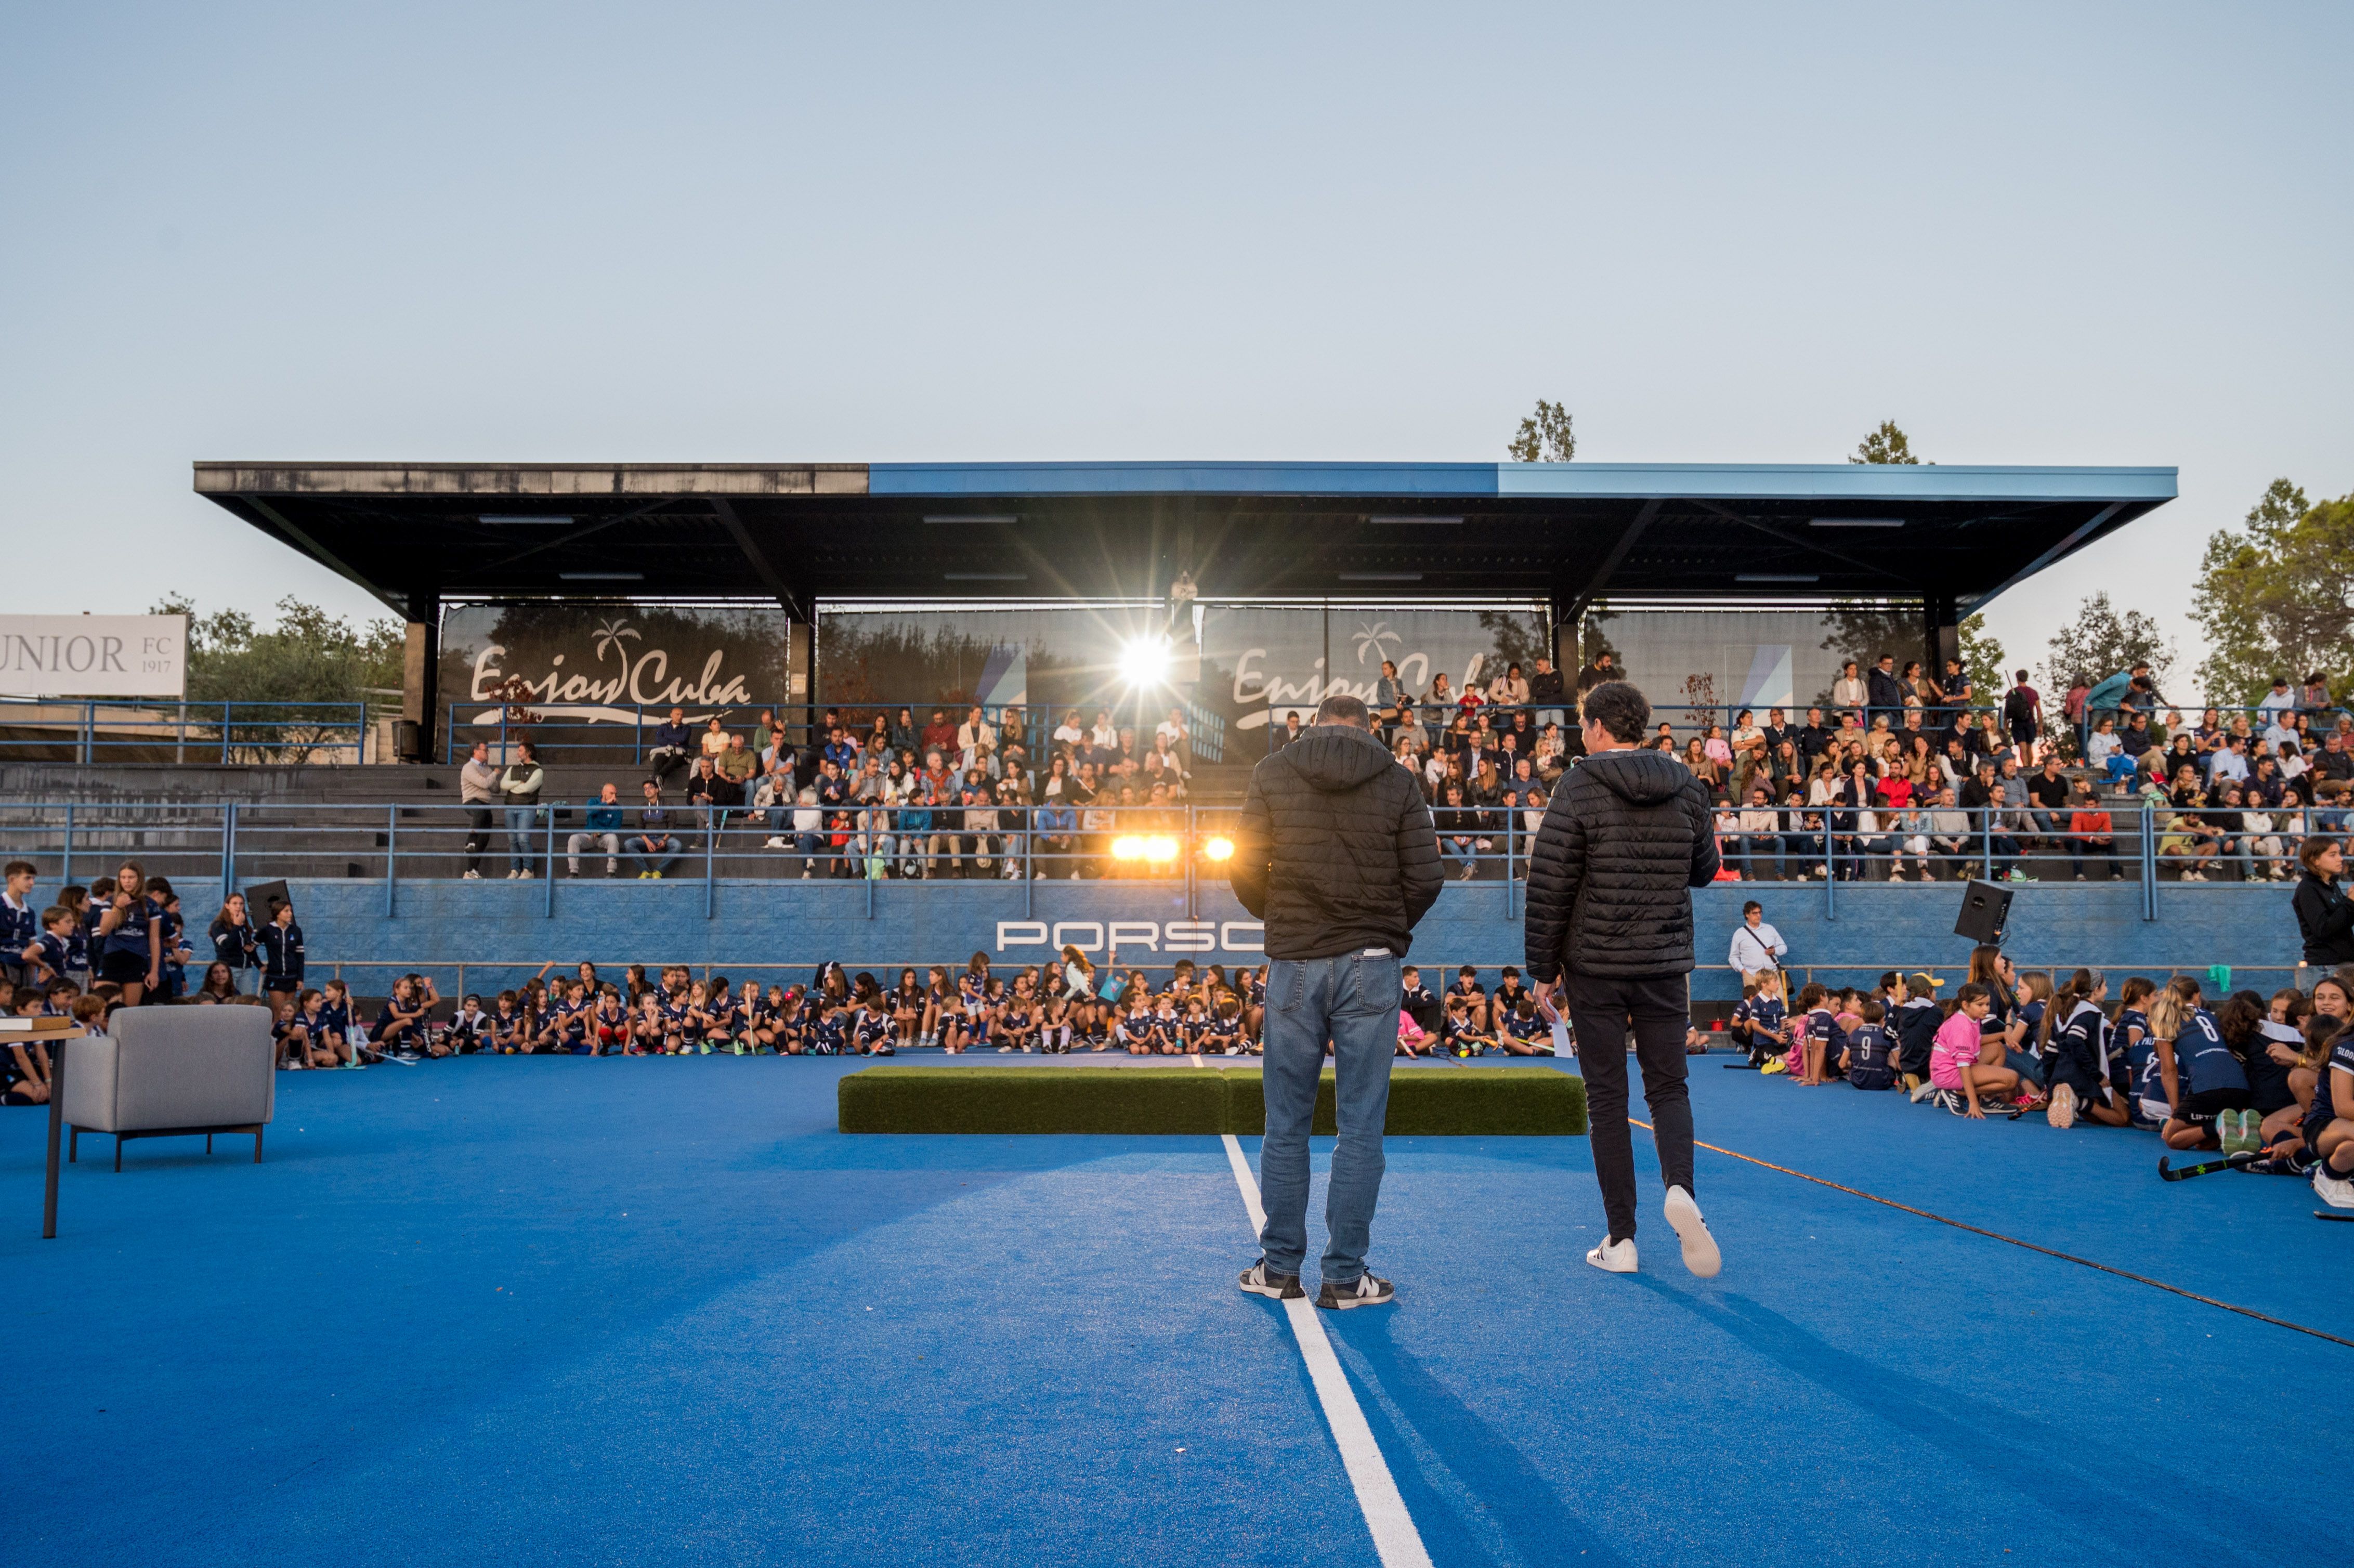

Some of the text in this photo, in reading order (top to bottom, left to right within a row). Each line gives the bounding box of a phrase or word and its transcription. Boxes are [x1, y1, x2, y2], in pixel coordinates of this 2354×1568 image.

[143, 637, 172, 655] FC
[142, 661, 171, 673] 1917
[630, 649, 750, 705] Cuba
[2195, 1015, 2219, 1042] 8
[1861, 1036, 1872, 1060] 9
